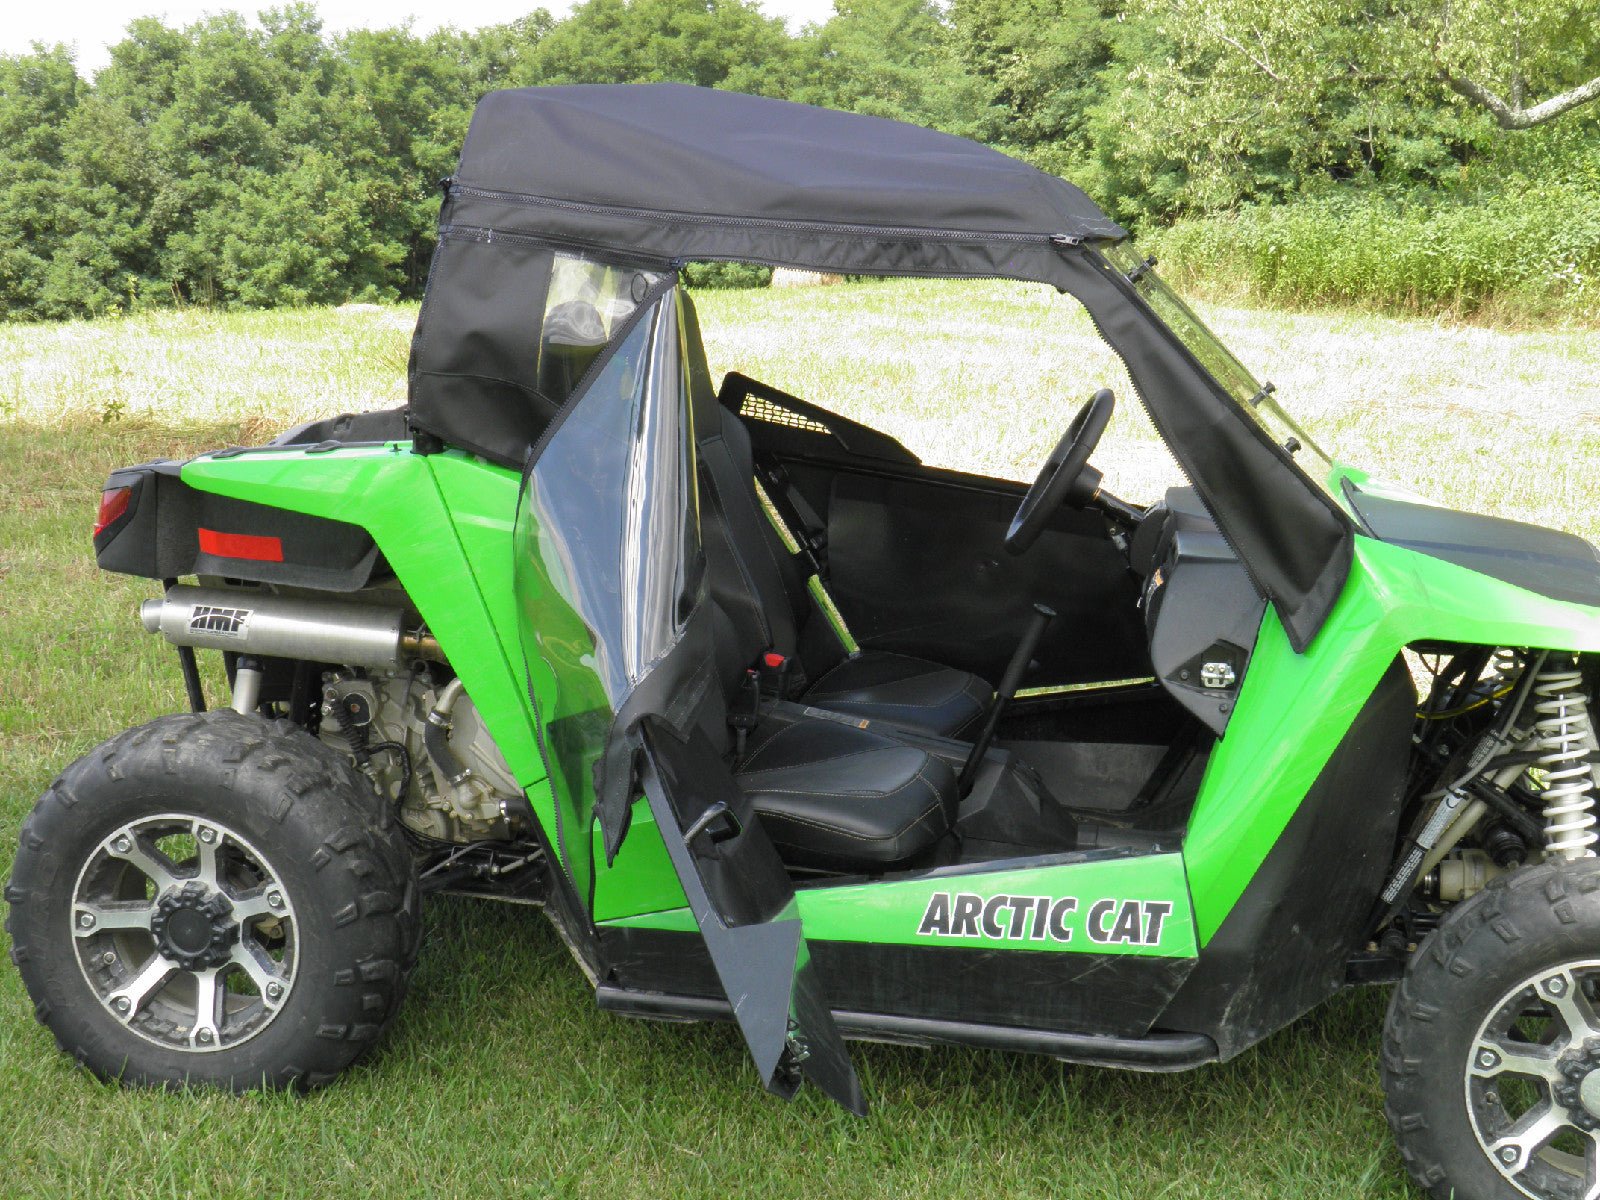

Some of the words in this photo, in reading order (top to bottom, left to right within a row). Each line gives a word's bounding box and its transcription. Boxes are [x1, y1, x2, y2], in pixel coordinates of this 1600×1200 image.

[190, 606, 250, 632] HMF
[917, 892, 1078, 942] ARCTIC
[1086, 899, 1173, 946] CAT
